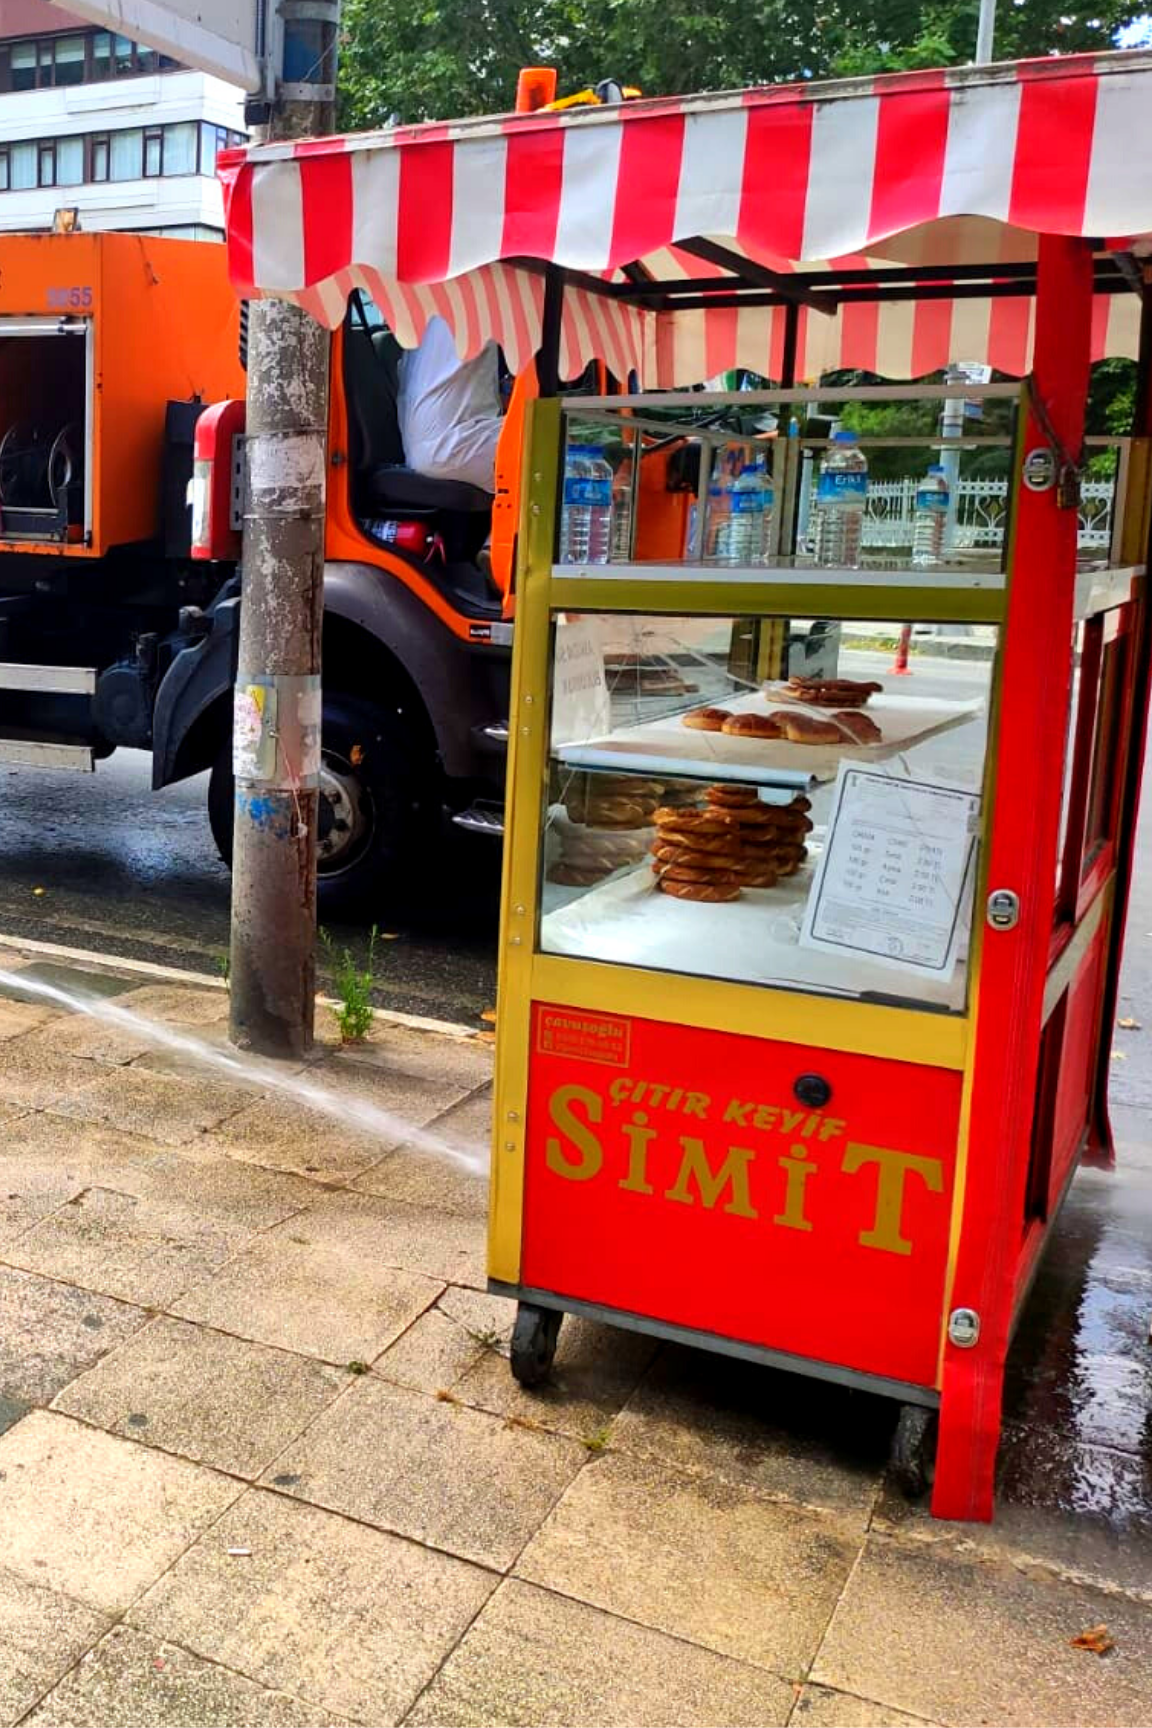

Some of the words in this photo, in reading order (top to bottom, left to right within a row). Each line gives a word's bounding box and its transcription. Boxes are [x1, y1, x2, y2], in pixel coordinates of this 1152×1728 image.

[46, 286, 93, 308] 55
[609, 1078, 711, 1119] ÇITIR
[723, 1099, 847, 1143] KEYİF
[547, 1083, 945, 1257] SİMİT
